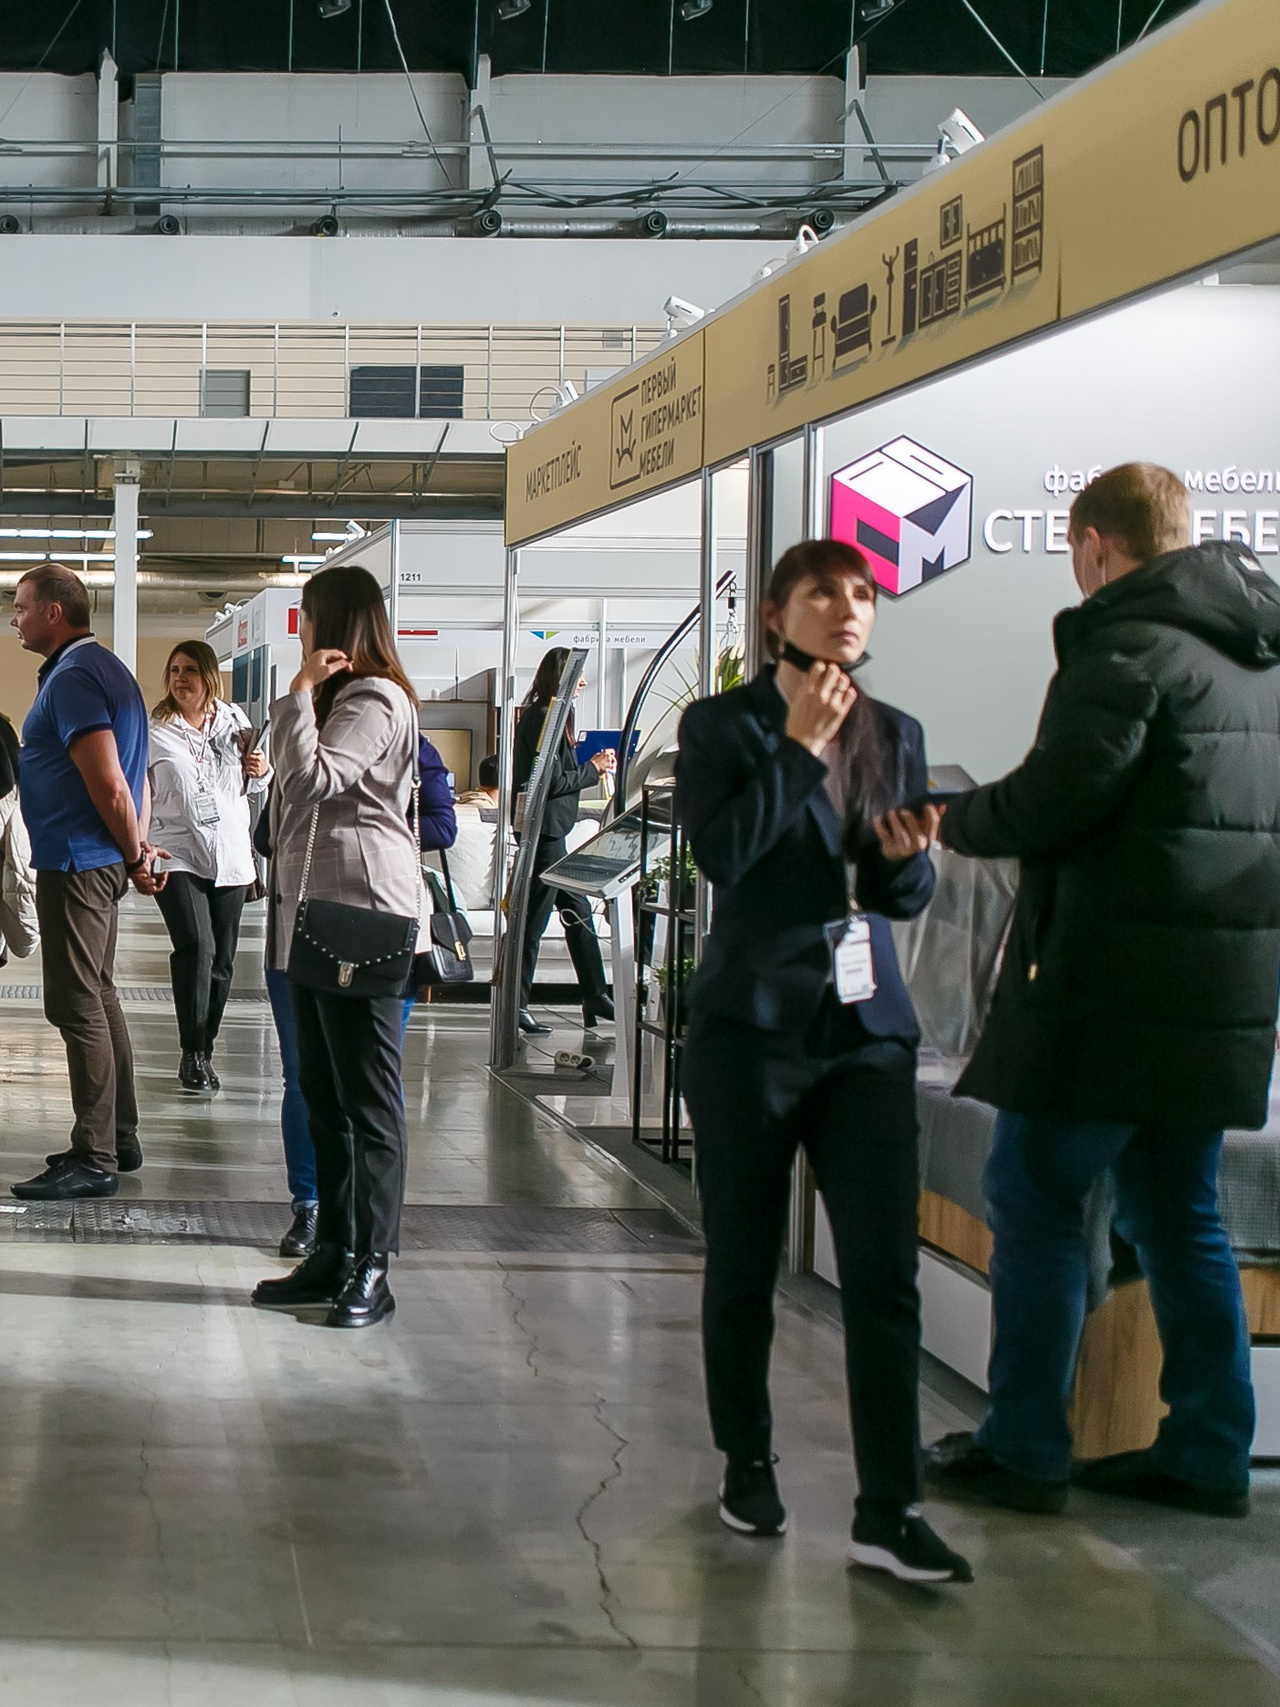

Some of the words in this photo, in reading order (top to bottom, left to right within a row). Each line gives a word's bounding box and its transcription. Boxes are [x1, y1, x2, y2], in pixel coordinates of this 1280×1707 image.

[1178, 67, 1280, 182] ОПТО
[641, 356, 677, 406] ПЕРВЫЙ
[641, 385, 702, 443] ГИПЕРМАРКЕТ
[525, 440, 582, 503] МАРКЕТПЛЕЙС
[639, 437, 675, 479] МЕБЕЛИ
[983, 509, 1070, 553] СТЕ
[400, 573, 421, 581] 1211
[614, 634, 646, 643] мебели
